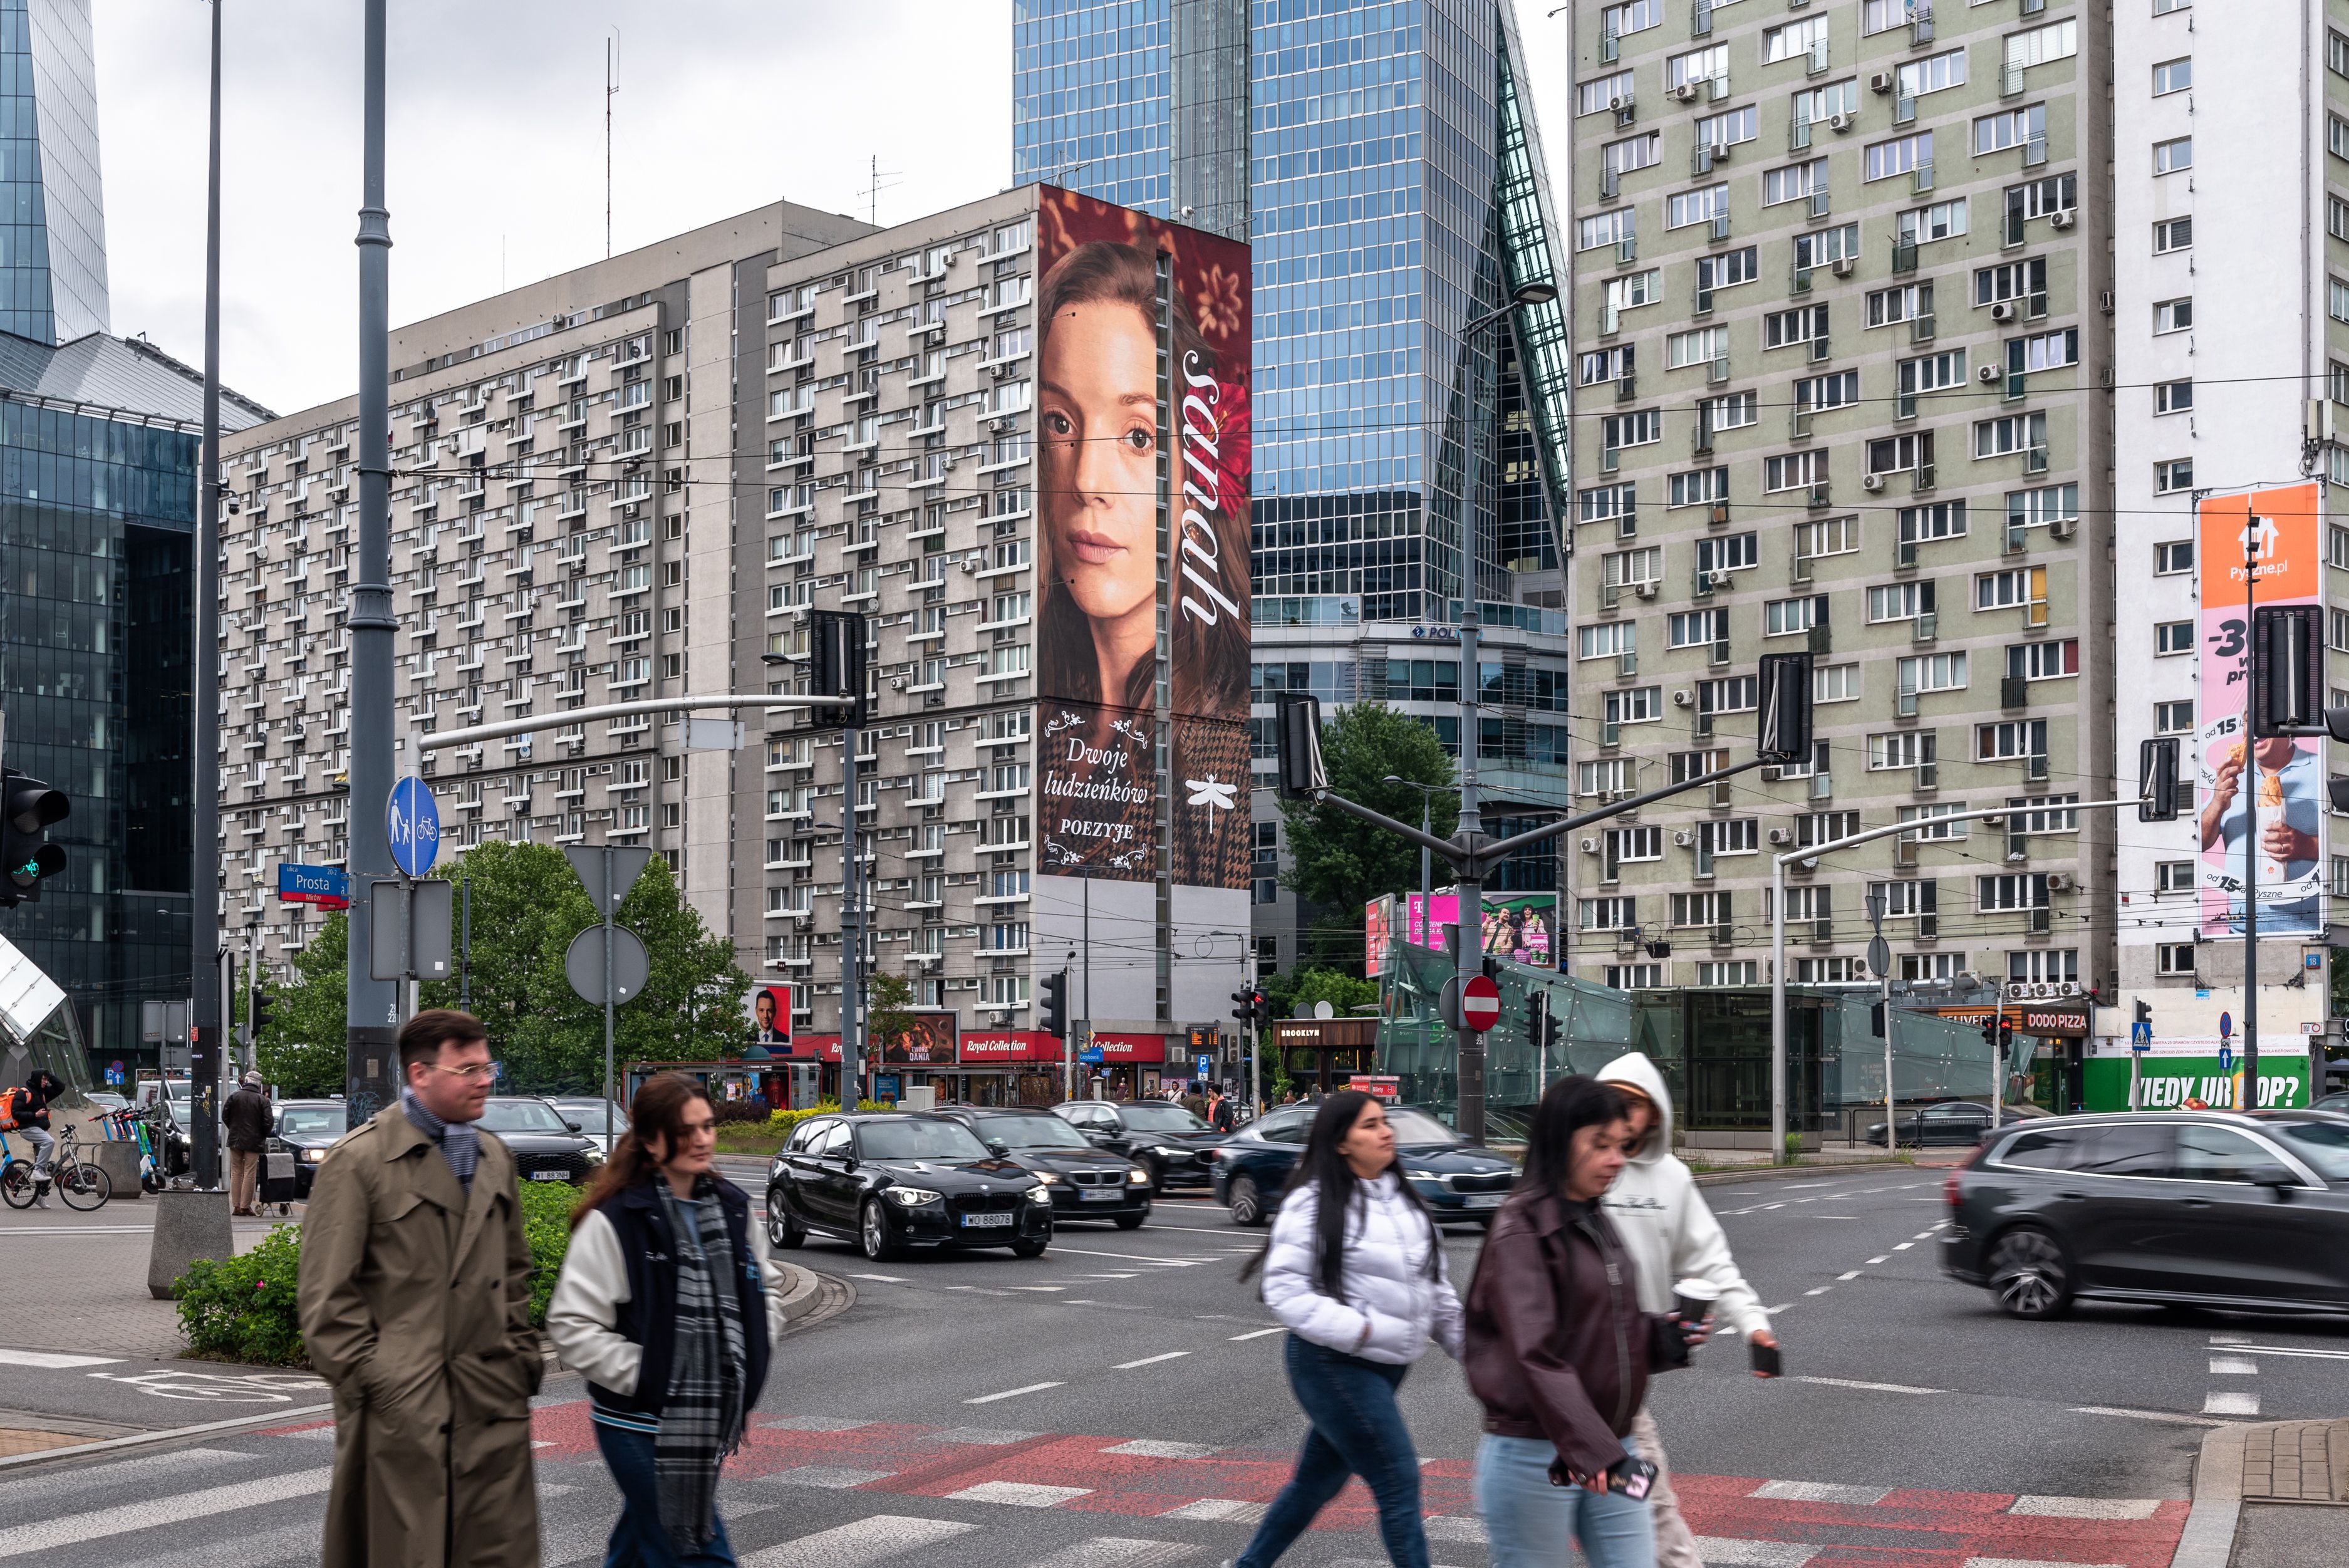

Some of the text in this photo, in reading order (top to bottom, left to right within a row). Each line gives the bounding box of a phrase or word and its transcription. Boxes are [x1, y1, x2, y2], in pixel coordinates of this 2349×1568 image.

[1181, 350, 1240, 626] sanah
[2230, 559, 2288, 581] Pyzne.pl
[2208, 619, 2248, 657] -3
[2205, 727, 2216, 739] od
[2217, 717, 2237, 735] 15
[1066, 737, 1128, 774] Dwoje
[1044, 770, 1148, 804] ludzieńków
[1059, 818, 1133, 843] POEZYJE
[296, 875, 329, 890] Prosta
[2206, 873, 2220, 882] od
[2219, 876, 2240, 893] 15
[2301, 868, 2320, 893] od 1
[2028, 1014, 2087, 1029] DODO PIZZA
[967, 1039, 1027, 1054] Royal Collection
[1200, 1056, 1206, 1067] P
[2127, 1076, 2300, 1108] KIEDY UROP?
[983, 1215, 1011, 1225] 88078
